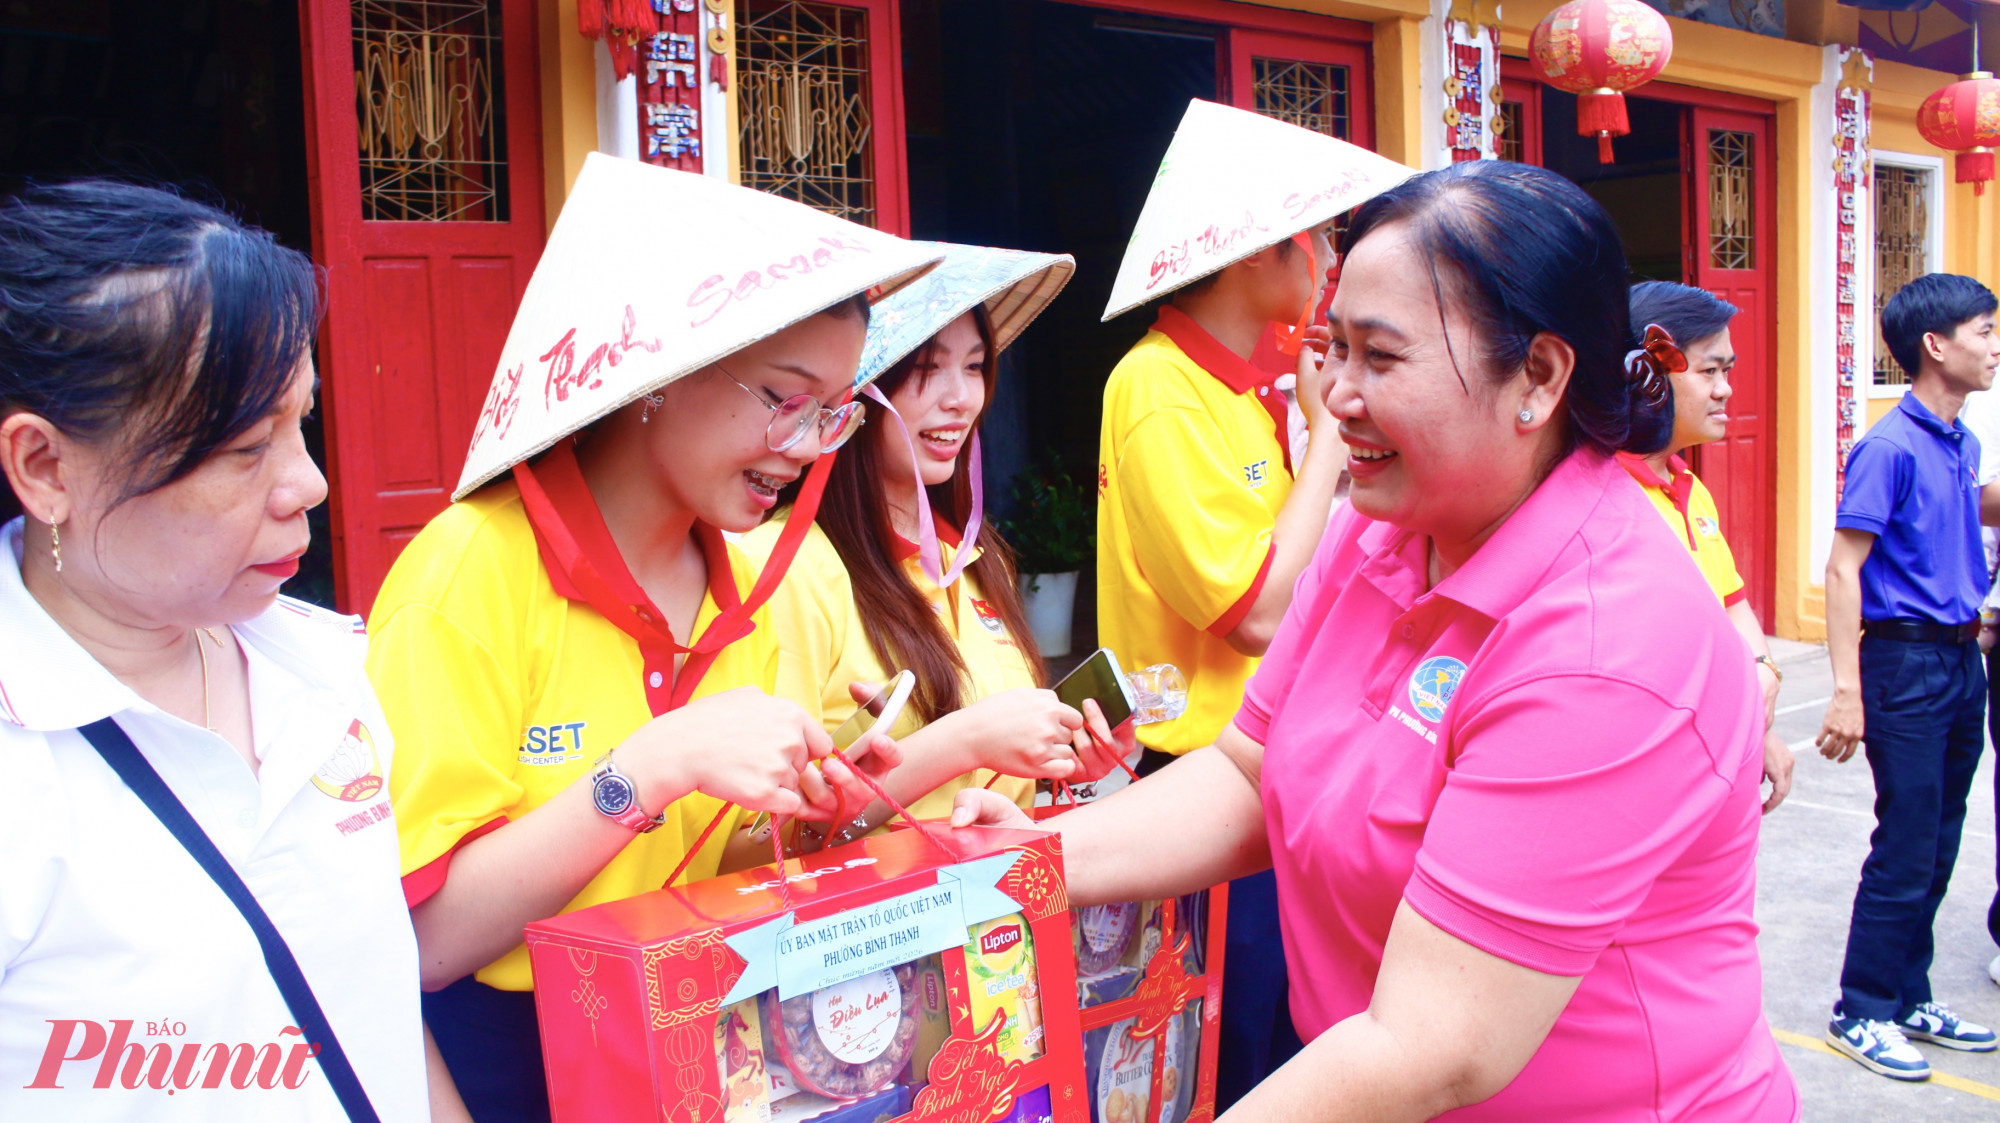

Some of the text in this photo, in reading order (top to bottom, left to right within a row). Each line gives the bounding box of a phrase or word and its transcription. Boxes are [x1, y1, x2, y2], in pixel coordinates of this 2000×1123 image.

[532, 755, 564, 765] CENTER
[796, 932, 816, 950] BAN
[910, 896, 931, 916] VIỆT
[932, 892, 953, 909] NAM
[889, 926, 920, 947] THẠNH
[983, 929, 1019, 950] Lipton
[926, 975, 937, 1007] Lipton
[986, 973, 1025, 997] ice tea
[829, 991, 889, 1029] Điều Lụa
[936, 1044, 979, 1082] Tết
